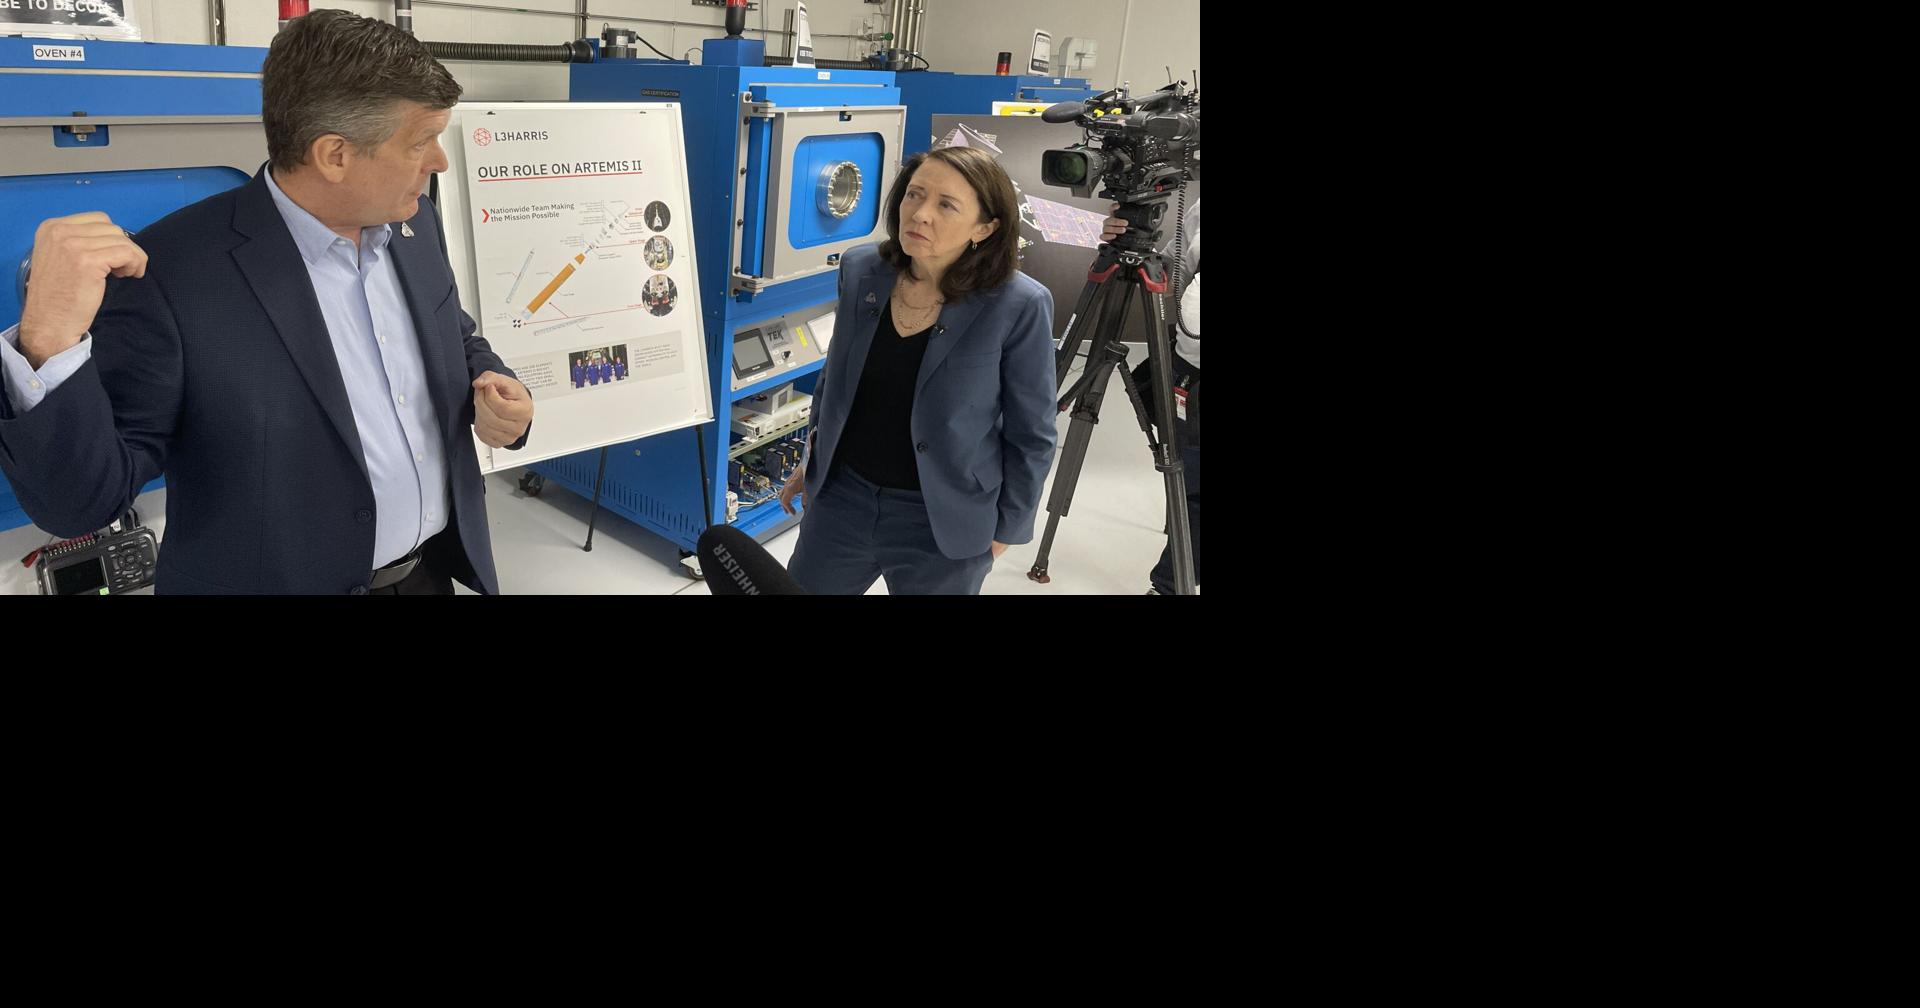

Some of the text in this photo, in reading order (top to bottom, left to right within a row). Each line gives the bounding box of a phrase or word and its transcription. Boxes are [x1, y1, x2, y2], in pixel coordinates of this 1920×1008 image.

[34, 48, 82, 58] OVEN #4
[494, 130, 549, 142] L3HARRIS
[478, 159, 642, 178] OUR ROLE ON ARTEMIS II
[490, 205, 530, 215] Nationwide
[531, 205, 550, 213] Team
[551, 203, 575, 211] Making
[531, 211, 560, 219] Possible
